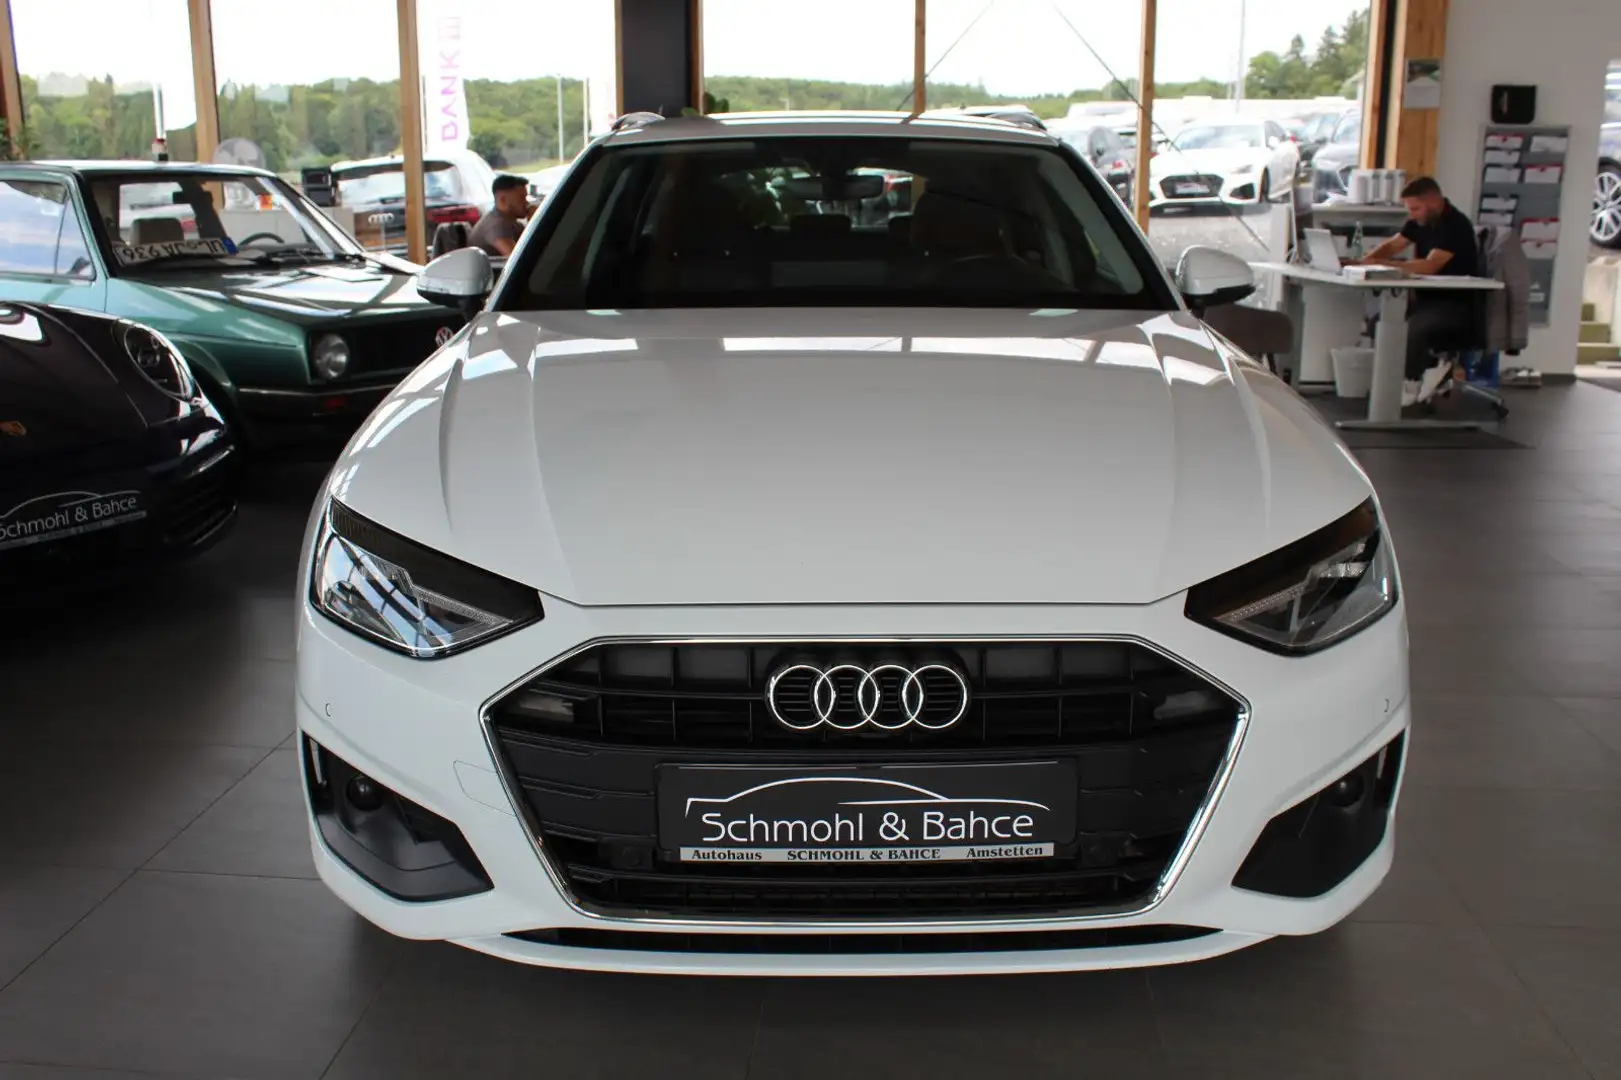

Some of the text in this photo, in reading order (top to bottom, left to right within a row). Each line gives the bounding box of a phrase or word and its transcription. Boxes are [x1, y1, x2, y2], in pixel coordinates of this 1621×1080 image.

[439, 50, 460, 140] BANK
[75, 506, 89, 522] &
[93, 497, 137, 519] Bahce
[702, 811, 1034, 842] Schmohl & Bahce
[692, 845, 1043, 861] Autohaus SCHMOHL & BAHCE Amstetten
